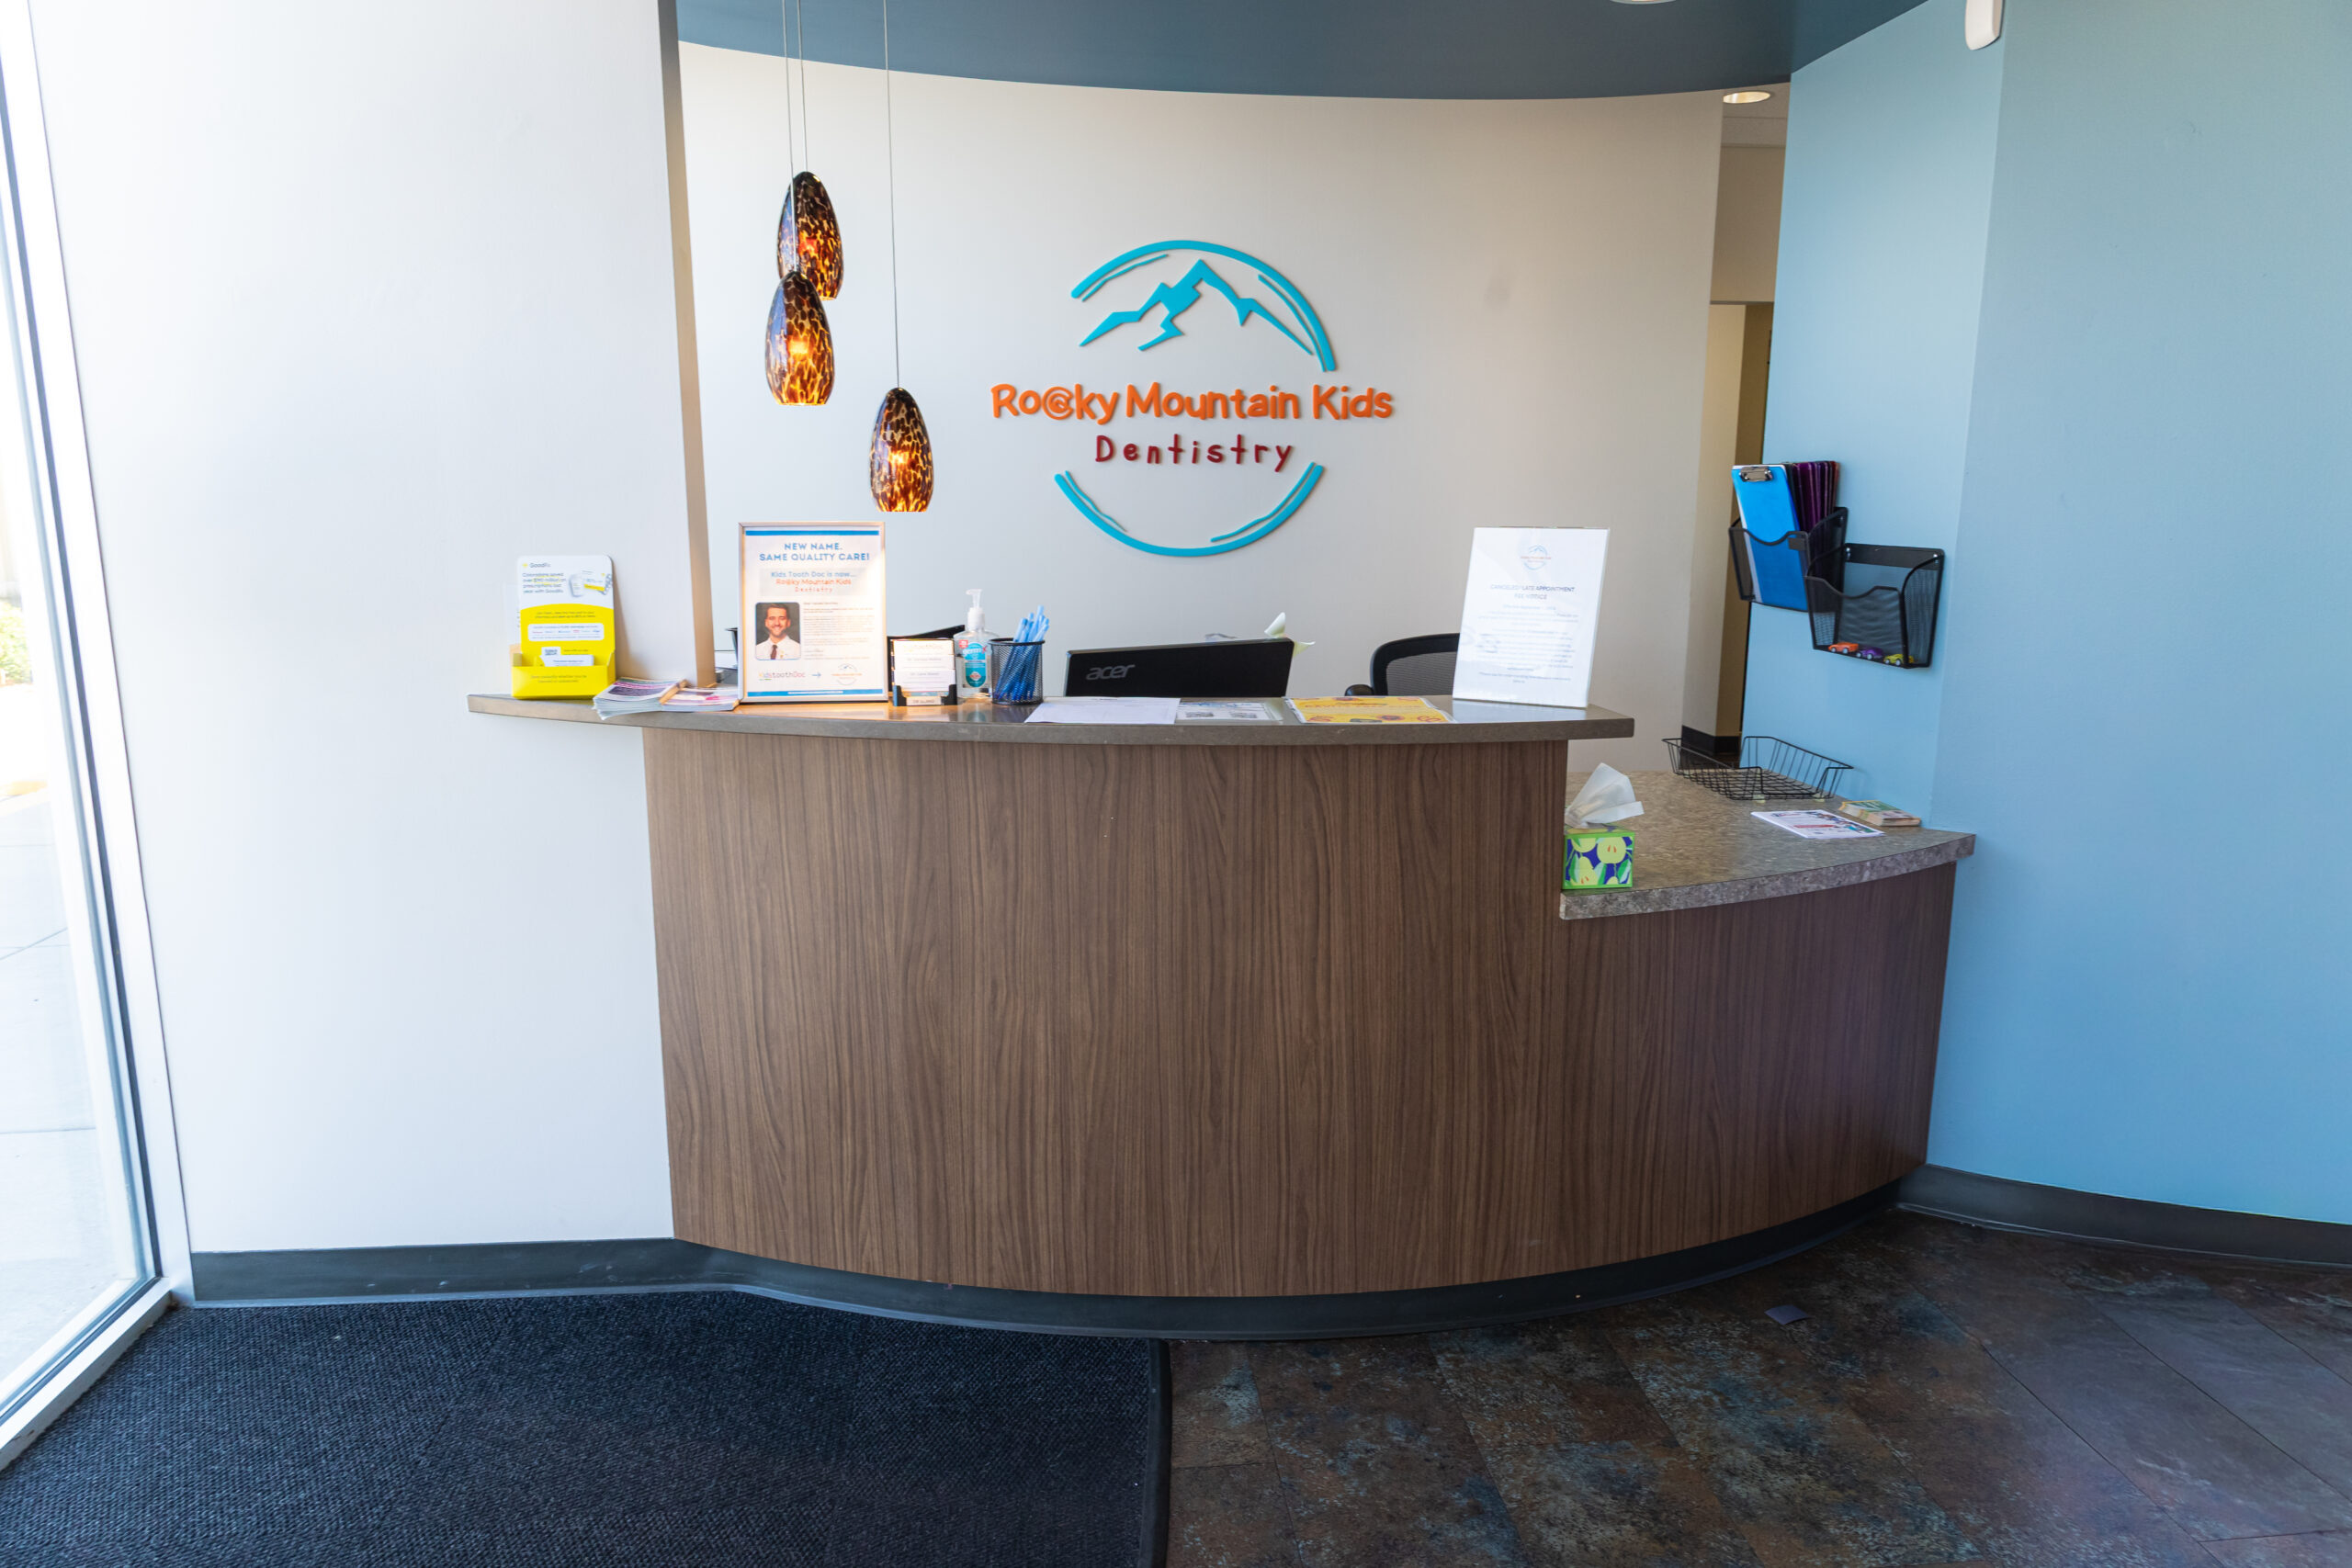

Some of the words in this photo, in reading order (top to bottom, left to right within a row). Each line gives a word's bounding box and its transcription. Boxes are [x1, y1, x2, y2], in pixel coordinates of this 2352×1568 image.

[1126, 382, 1300, 420] Mountain
[1313, 384, 1394, 421] Kids
[1095, 434, 1294, 472] Dentistry
[759, 553, 787, 561] SAME
[791, 553, 835, 561] QUALITY
[838, 552, 870, 561] CARE!
[1086, 664, 1136, 680] acer
